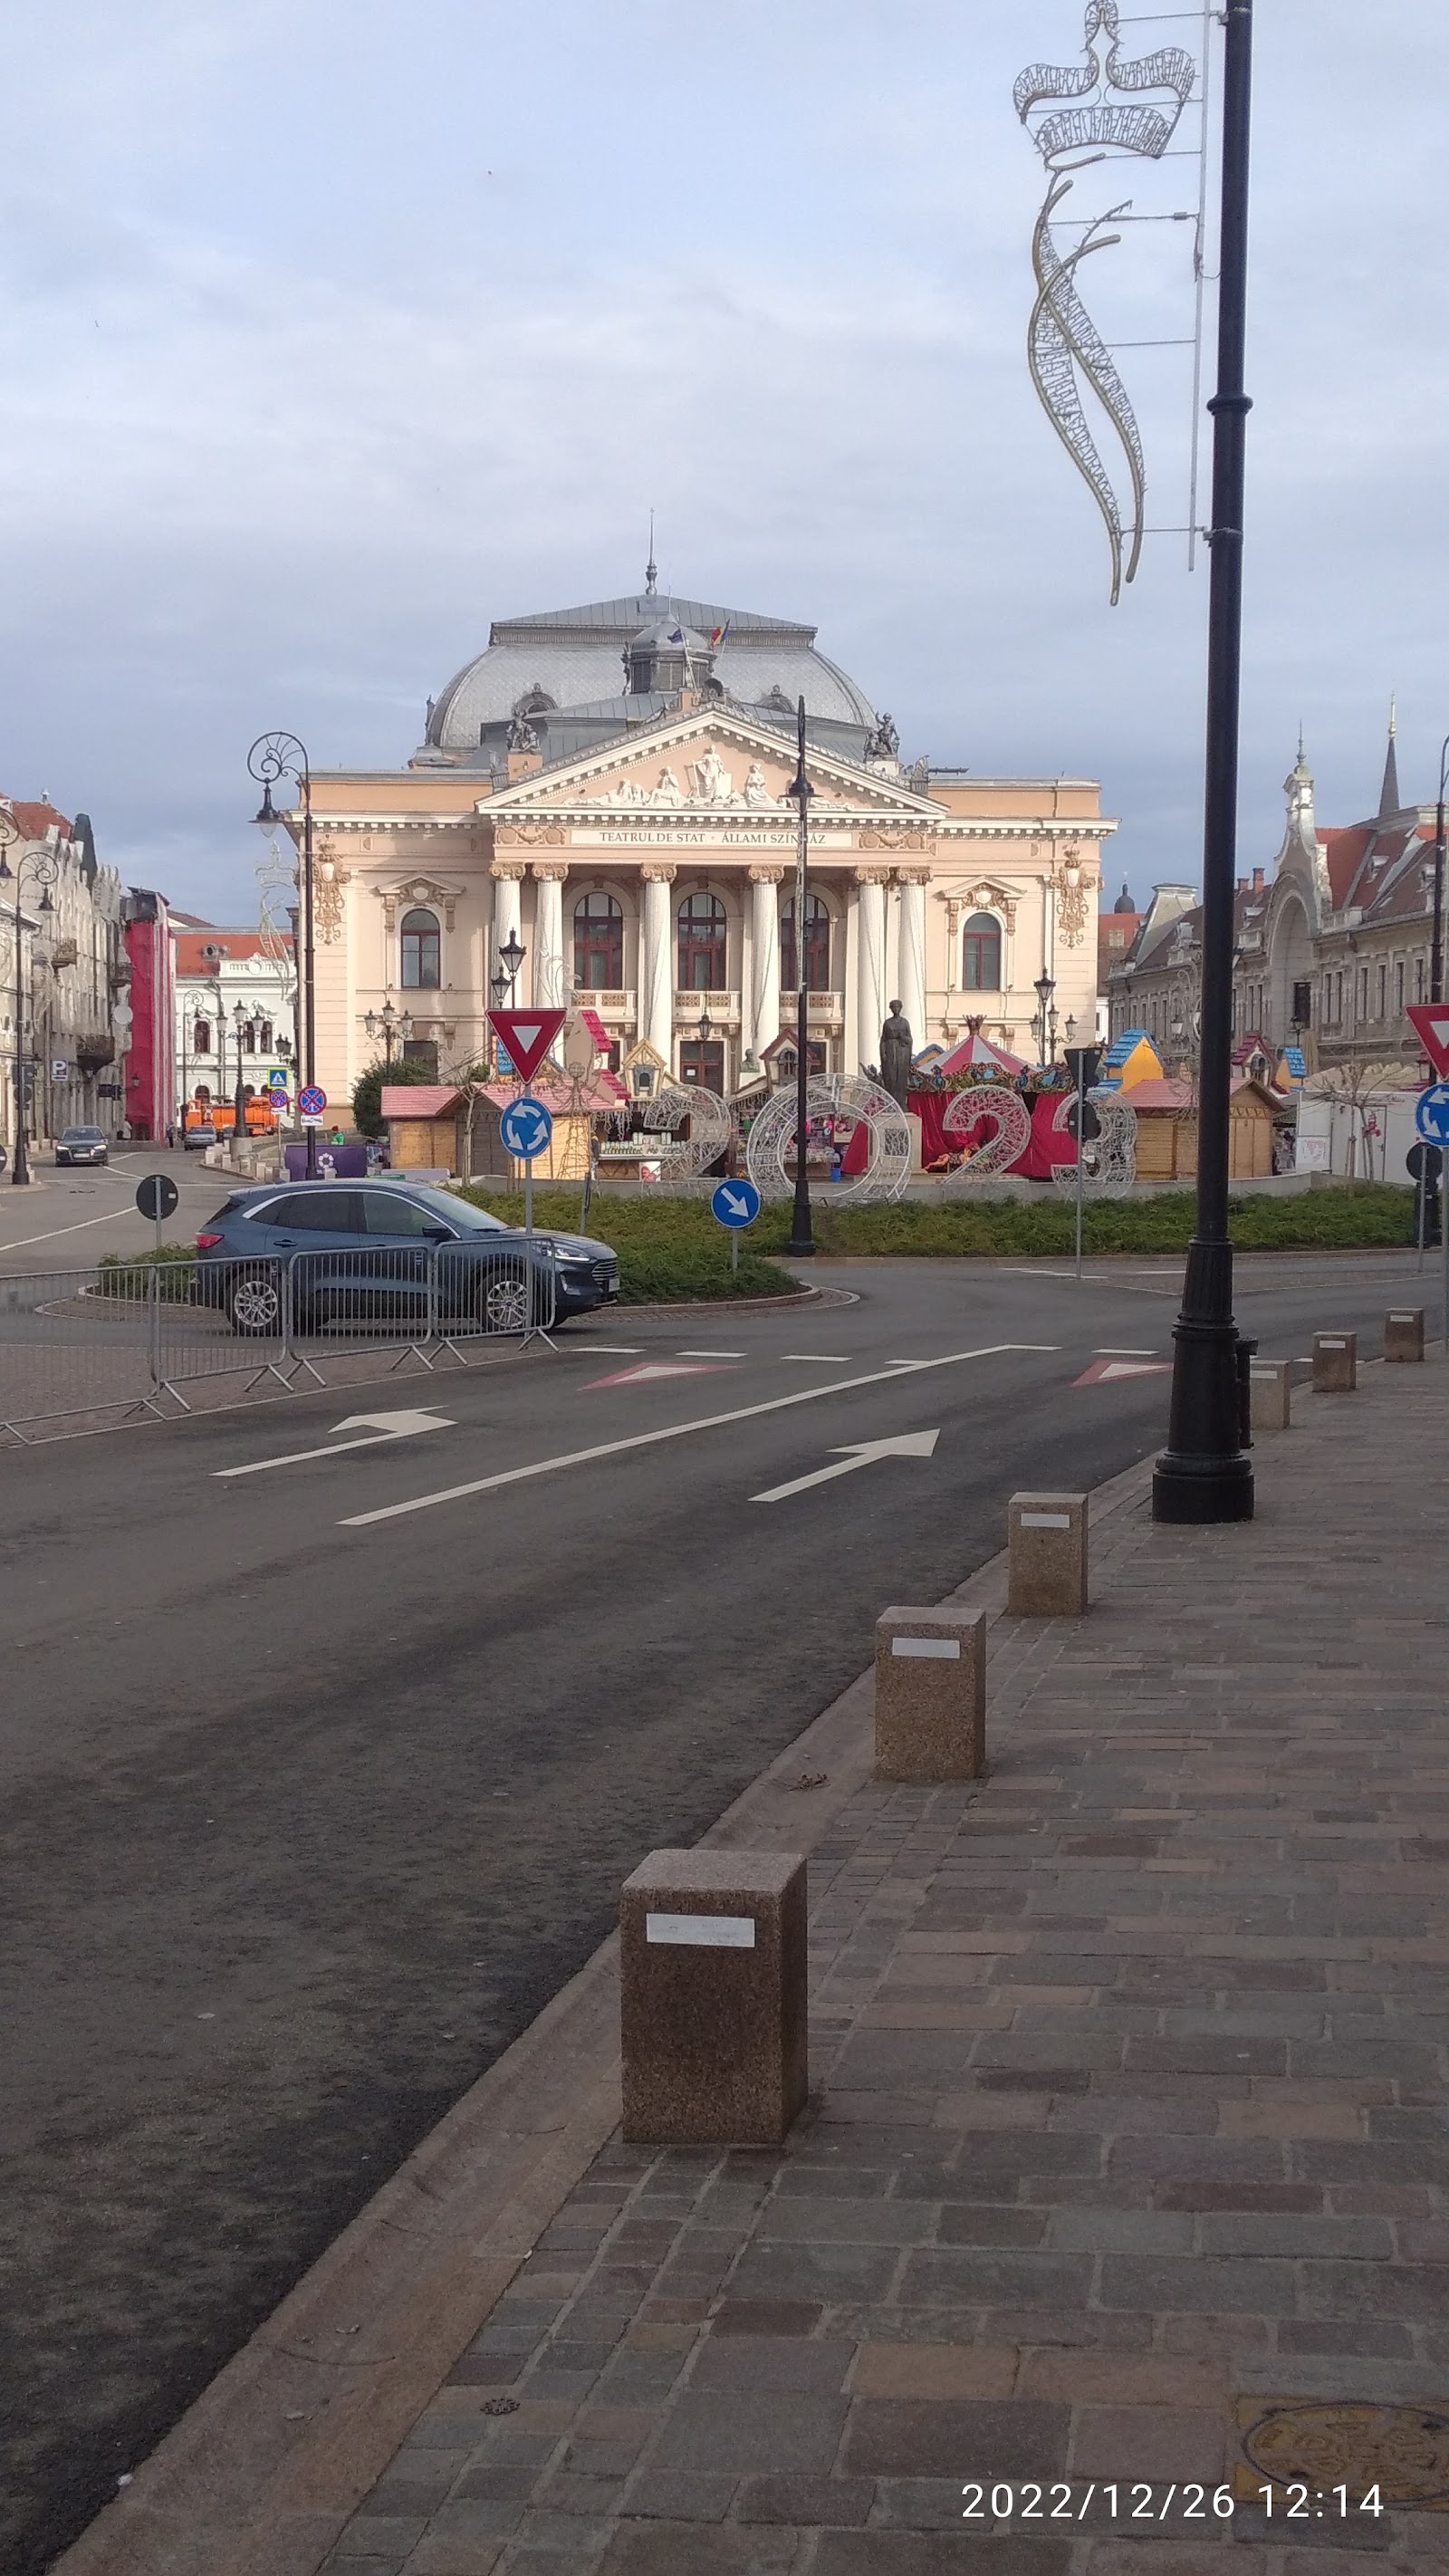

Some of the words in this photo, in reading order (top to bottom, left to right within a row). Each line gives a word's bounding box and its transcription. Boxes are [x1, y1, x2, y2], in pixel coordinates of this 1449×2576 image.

[600, 831, 654, 842] TEATRUL
[656, 832, 673, 842] DE
[676, 832, 705, 843] STAT
[721, 831, 767, 843] ÁLLAMI
[770, 831, 826, 844] SZÍNÁZ
[52, 1060, 66, 1075] P
